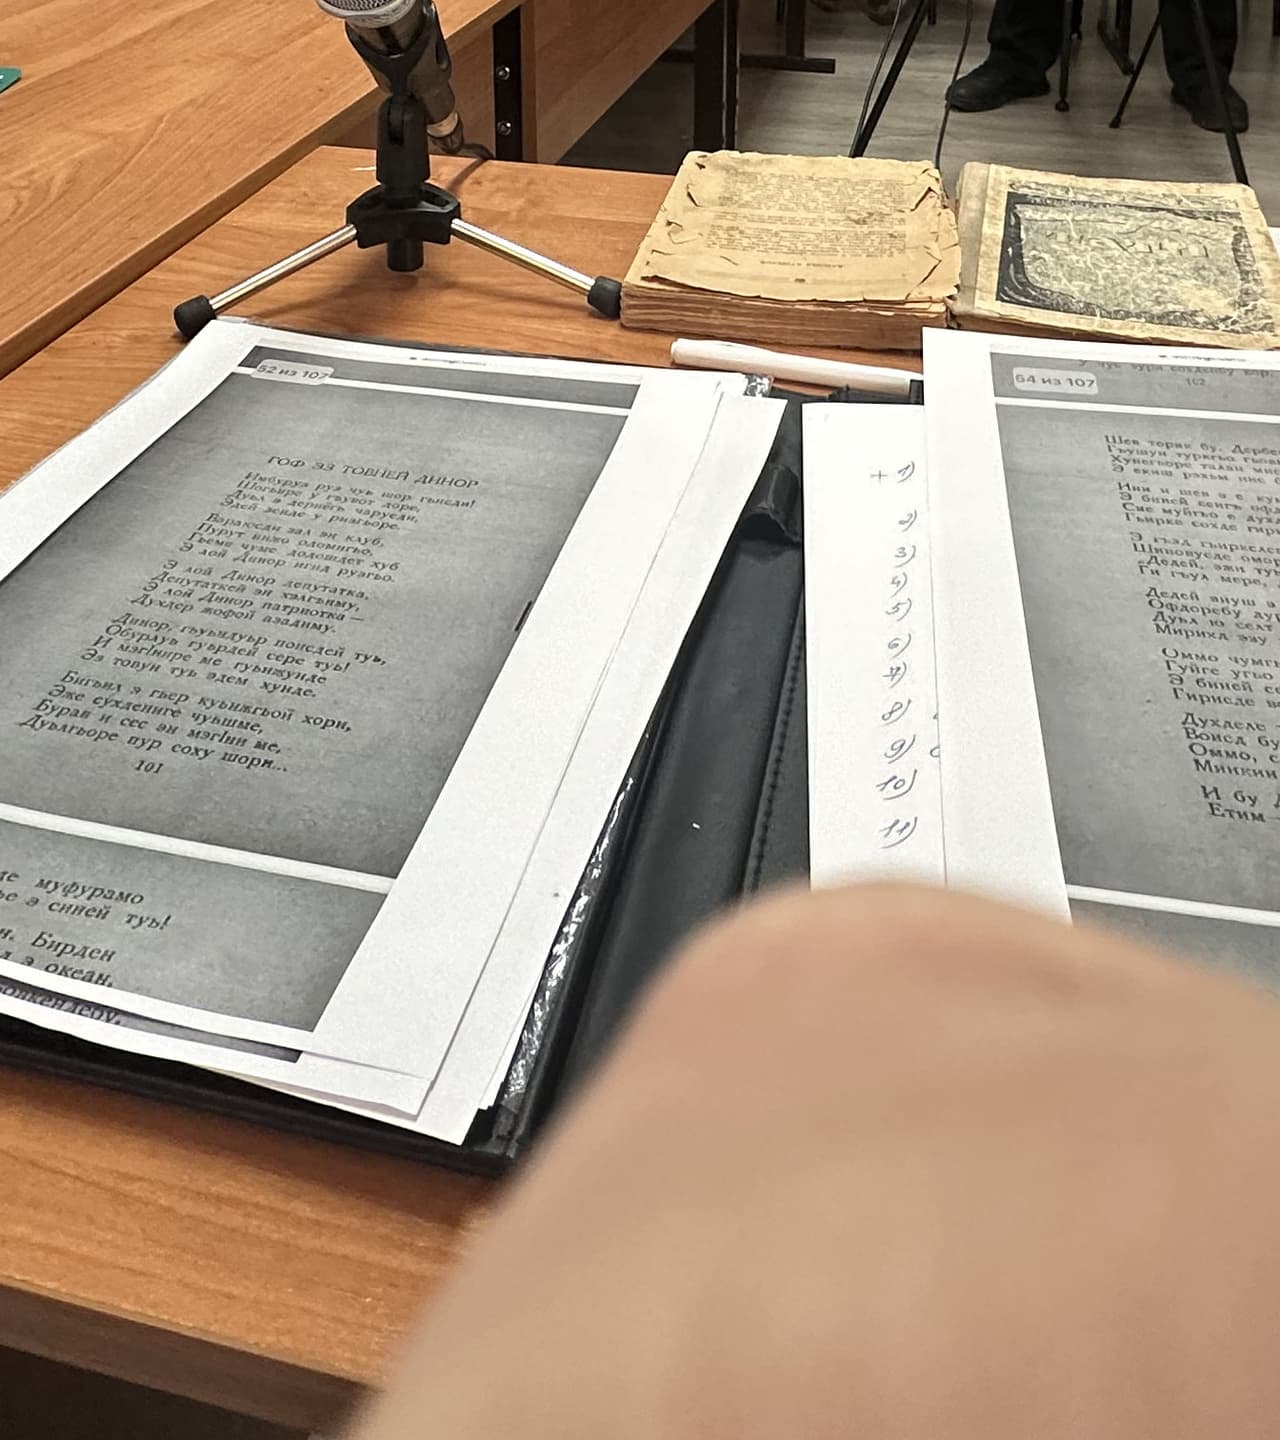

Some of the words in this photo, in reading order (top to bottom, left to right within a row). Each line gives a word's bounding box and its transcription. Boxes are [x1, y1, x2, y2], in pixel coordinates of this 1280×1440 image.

[257, 364, 275, 375] 52
[278, 368, 297, 378] из
[1042, 378, 1061, 387] из
[1068, 377, 1095, 388] 107
[894, 545, 916, 568] 3)
[885, 598, 913, 622] 5)
[887, 633, 912, 660] 6)
[881, 699, 912, 725] 8)
[883, 734, 916, 765] 9)
[875, 768, 918, 801] 10)
[30, 931, 117, 962] Бирден
[44, 964, 114, 987] океан.
